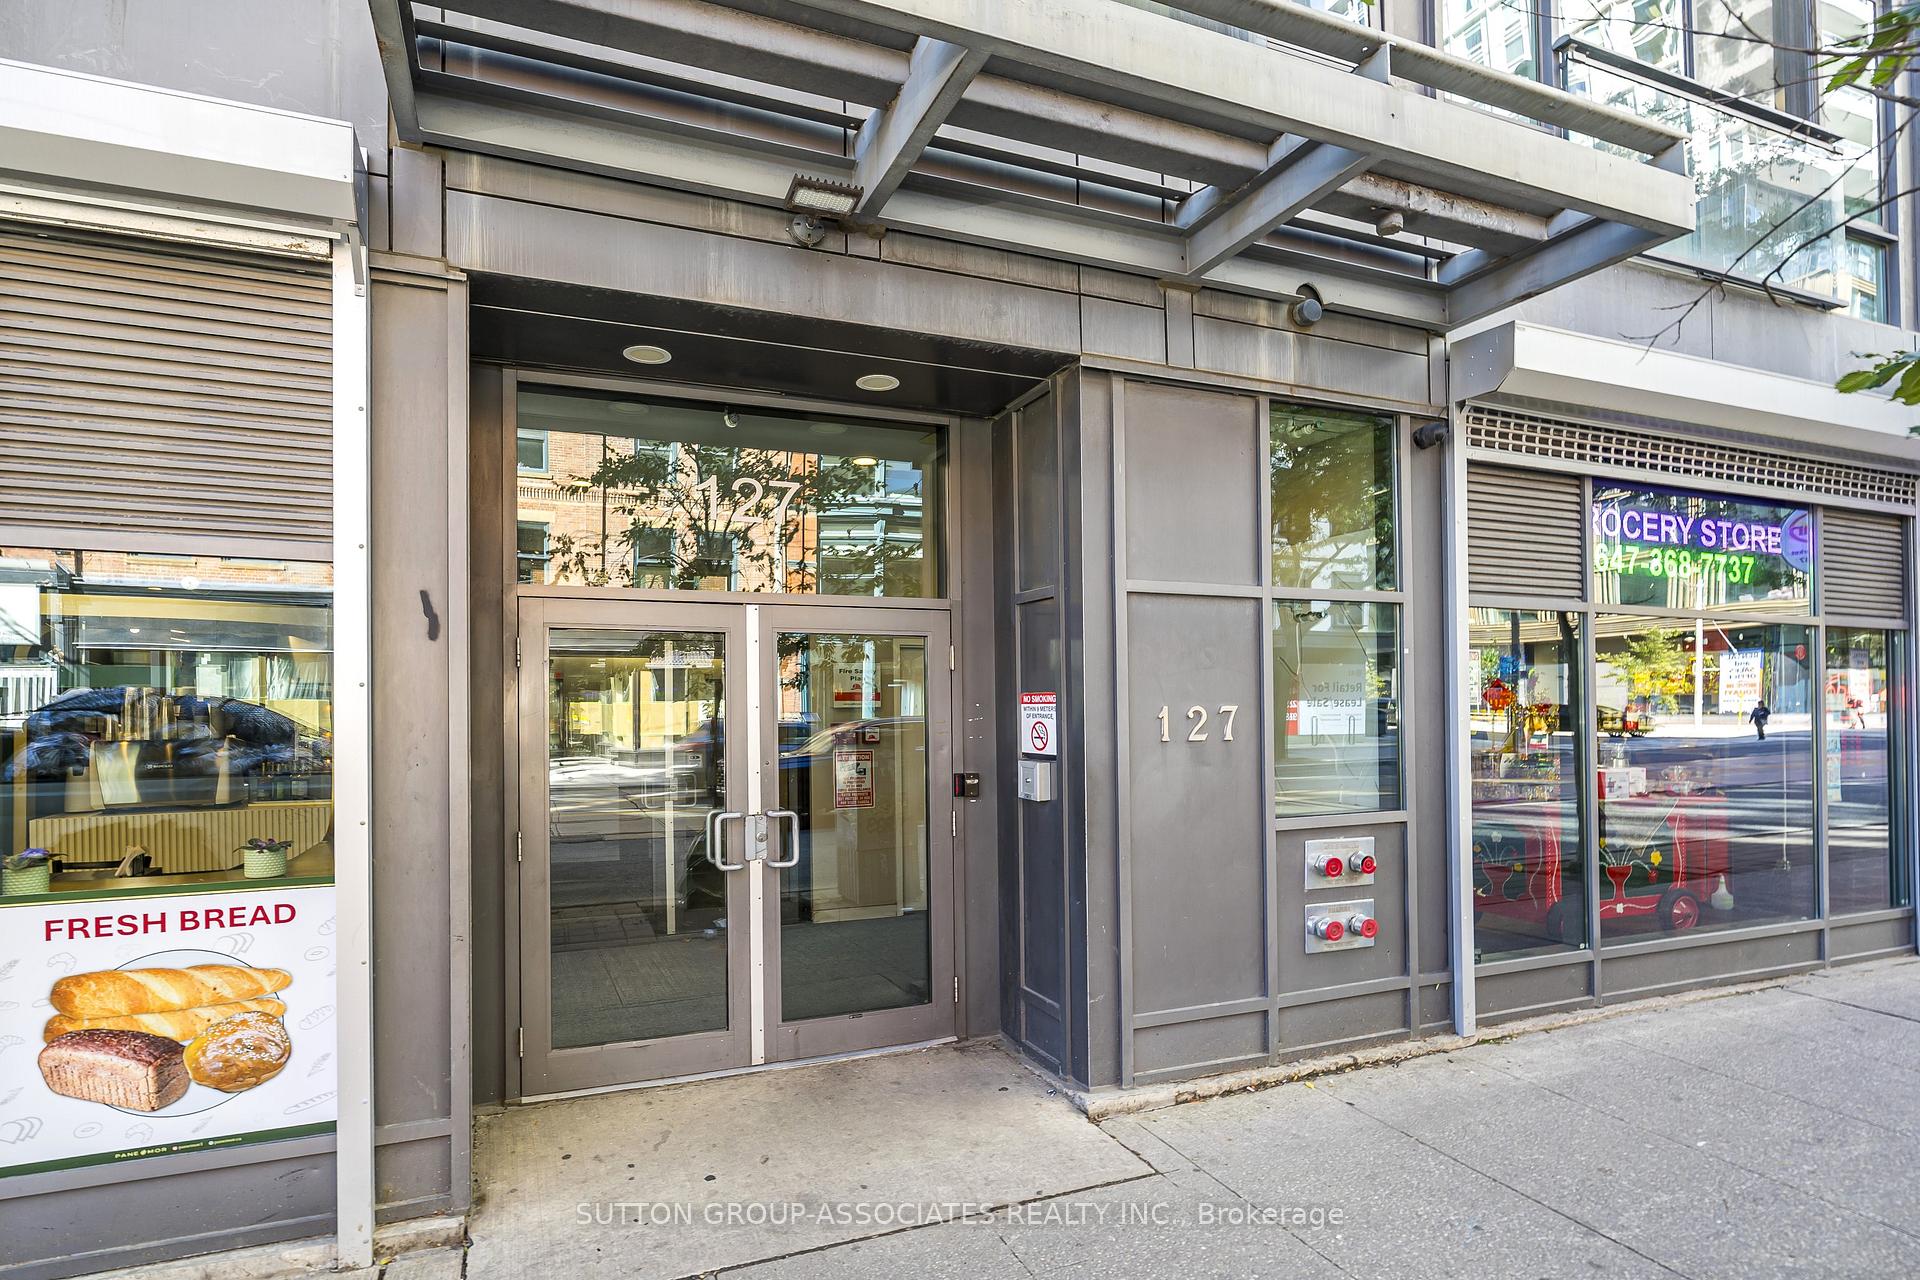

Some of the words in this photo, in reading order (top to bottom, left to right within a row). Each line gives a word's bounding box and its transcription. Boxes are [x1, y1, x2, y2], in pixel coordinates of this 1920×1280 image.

[696, 475, 801, 523] 127
[1701, 520, 1781, 554] STORE
[1023, 695, 1031, 703] NO
[1031, 694, 1056, 703] SMOKING
[1158, 705, 1239, 742] 127
[44, 912, 167, 942] FRESH
[180, 903, 297, 932] BREAD
